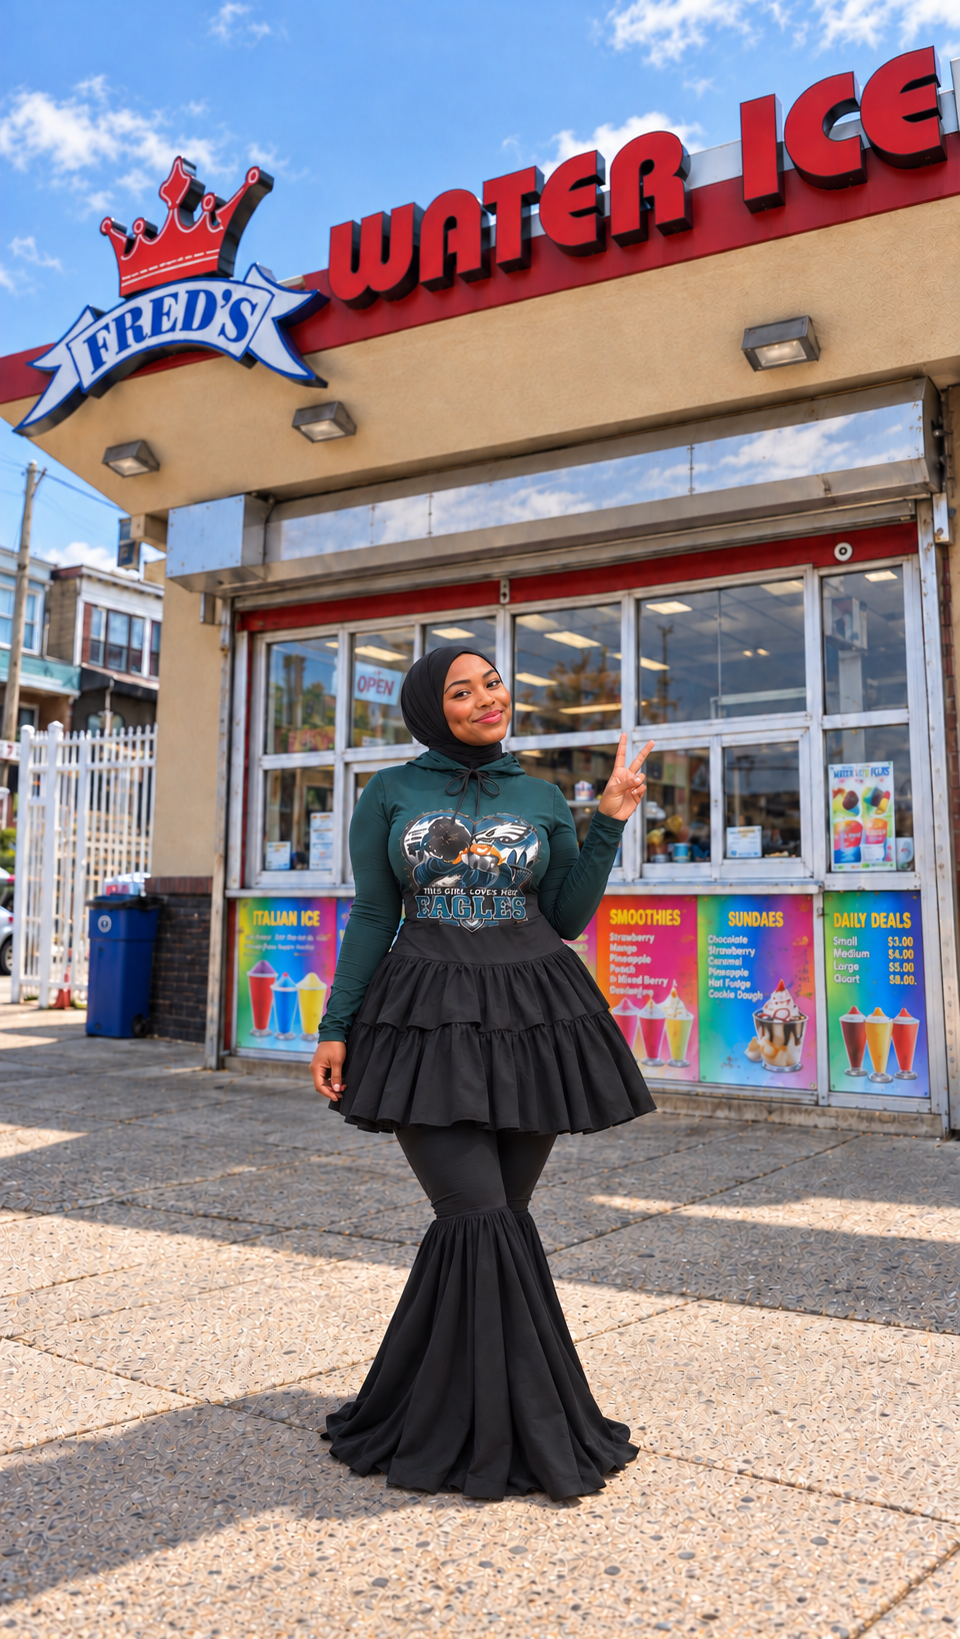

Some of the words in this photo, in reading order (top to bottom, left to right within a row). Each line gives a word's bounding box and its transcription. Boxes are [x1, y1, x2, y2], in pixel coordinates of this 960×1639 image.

[329, 131, 690, 304] WATER
[740, 46, 946, 211] ICE
[82, 289, 259, 375] FRED'S
[357, 675, 395, 696] OPEN
[415, 895, 526, 919] EAGLES
[253, 910, 297, 926] ITALIAN
[301, 910, 320, 926] ICE
[609, 909, 681, 926] SMOOTHIES
[728, 911, 784, 927] SUNDAES
[833, 912, 867, 928] DAILY
[871, 912, 911, 928] DEALS
[609, 932, 655, 944] Strawberry
[708, 934, 748, 944] Chocolate
[833, 936, 857, 946] Small
[609, 943, 637, 955] Mango
[708, 946, 755, 957] Strawberry
[833, 948, 870, 958] Medium
[609, 953, 651, 965] Pineapple
[708, 956, 742, 966] Caramel
[708, 967, 749, 978] Pineapple
[834, 960, 860, 973] Large
[889, 962, 915, 973] $5.00
[643, 975, 668, 987] Berry
[725, 979, 751, 990] Fudge
[834, 974, 860, 984] Quart
[708, 989, 735, 999] Cookie
[737, 990, 763, 1003] Dough
